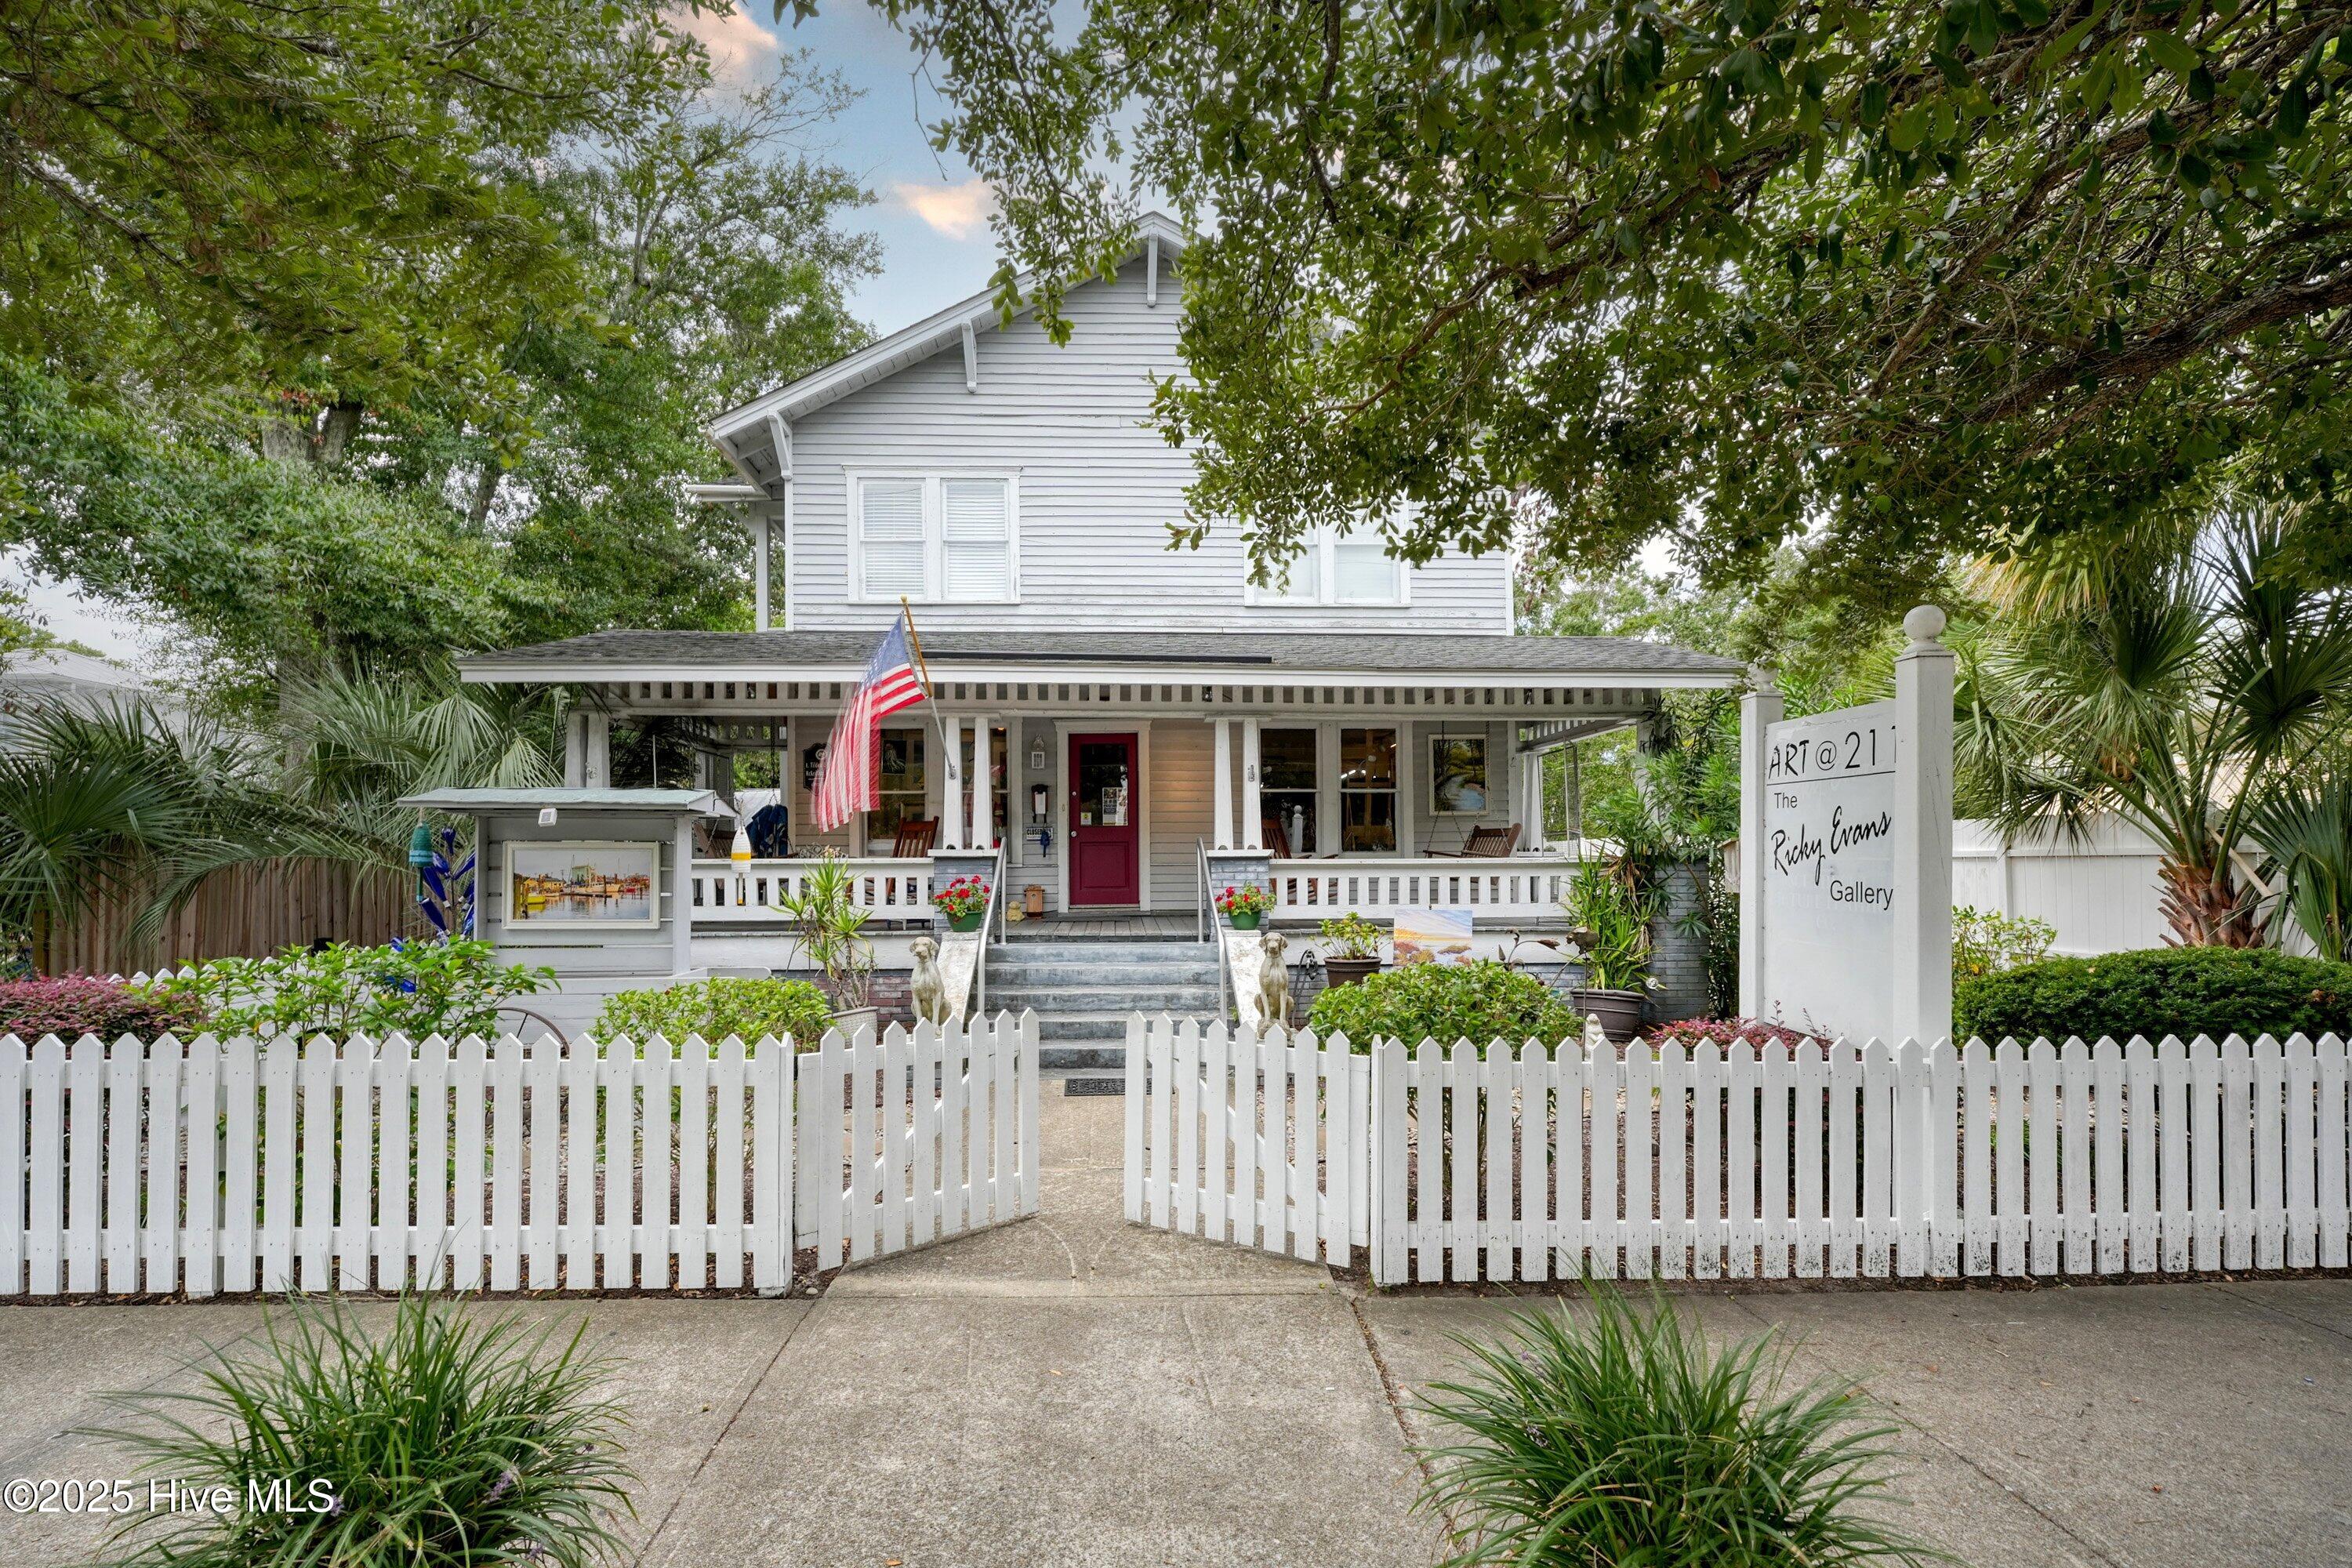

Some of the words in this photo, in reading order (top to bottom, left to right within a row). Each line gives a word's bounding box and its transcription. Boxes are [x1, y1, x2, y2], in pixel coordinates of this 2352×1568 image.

[1769, 740, 1809, 779] ART
[1816, 740, 1837, 771] @
[1774, 792, 1798, 809] The
[1771, 823, 1826, 886] Ricky
[1831, 805, 1892, 854] Evans
[1830, 880, 1893, 911] Gallery
